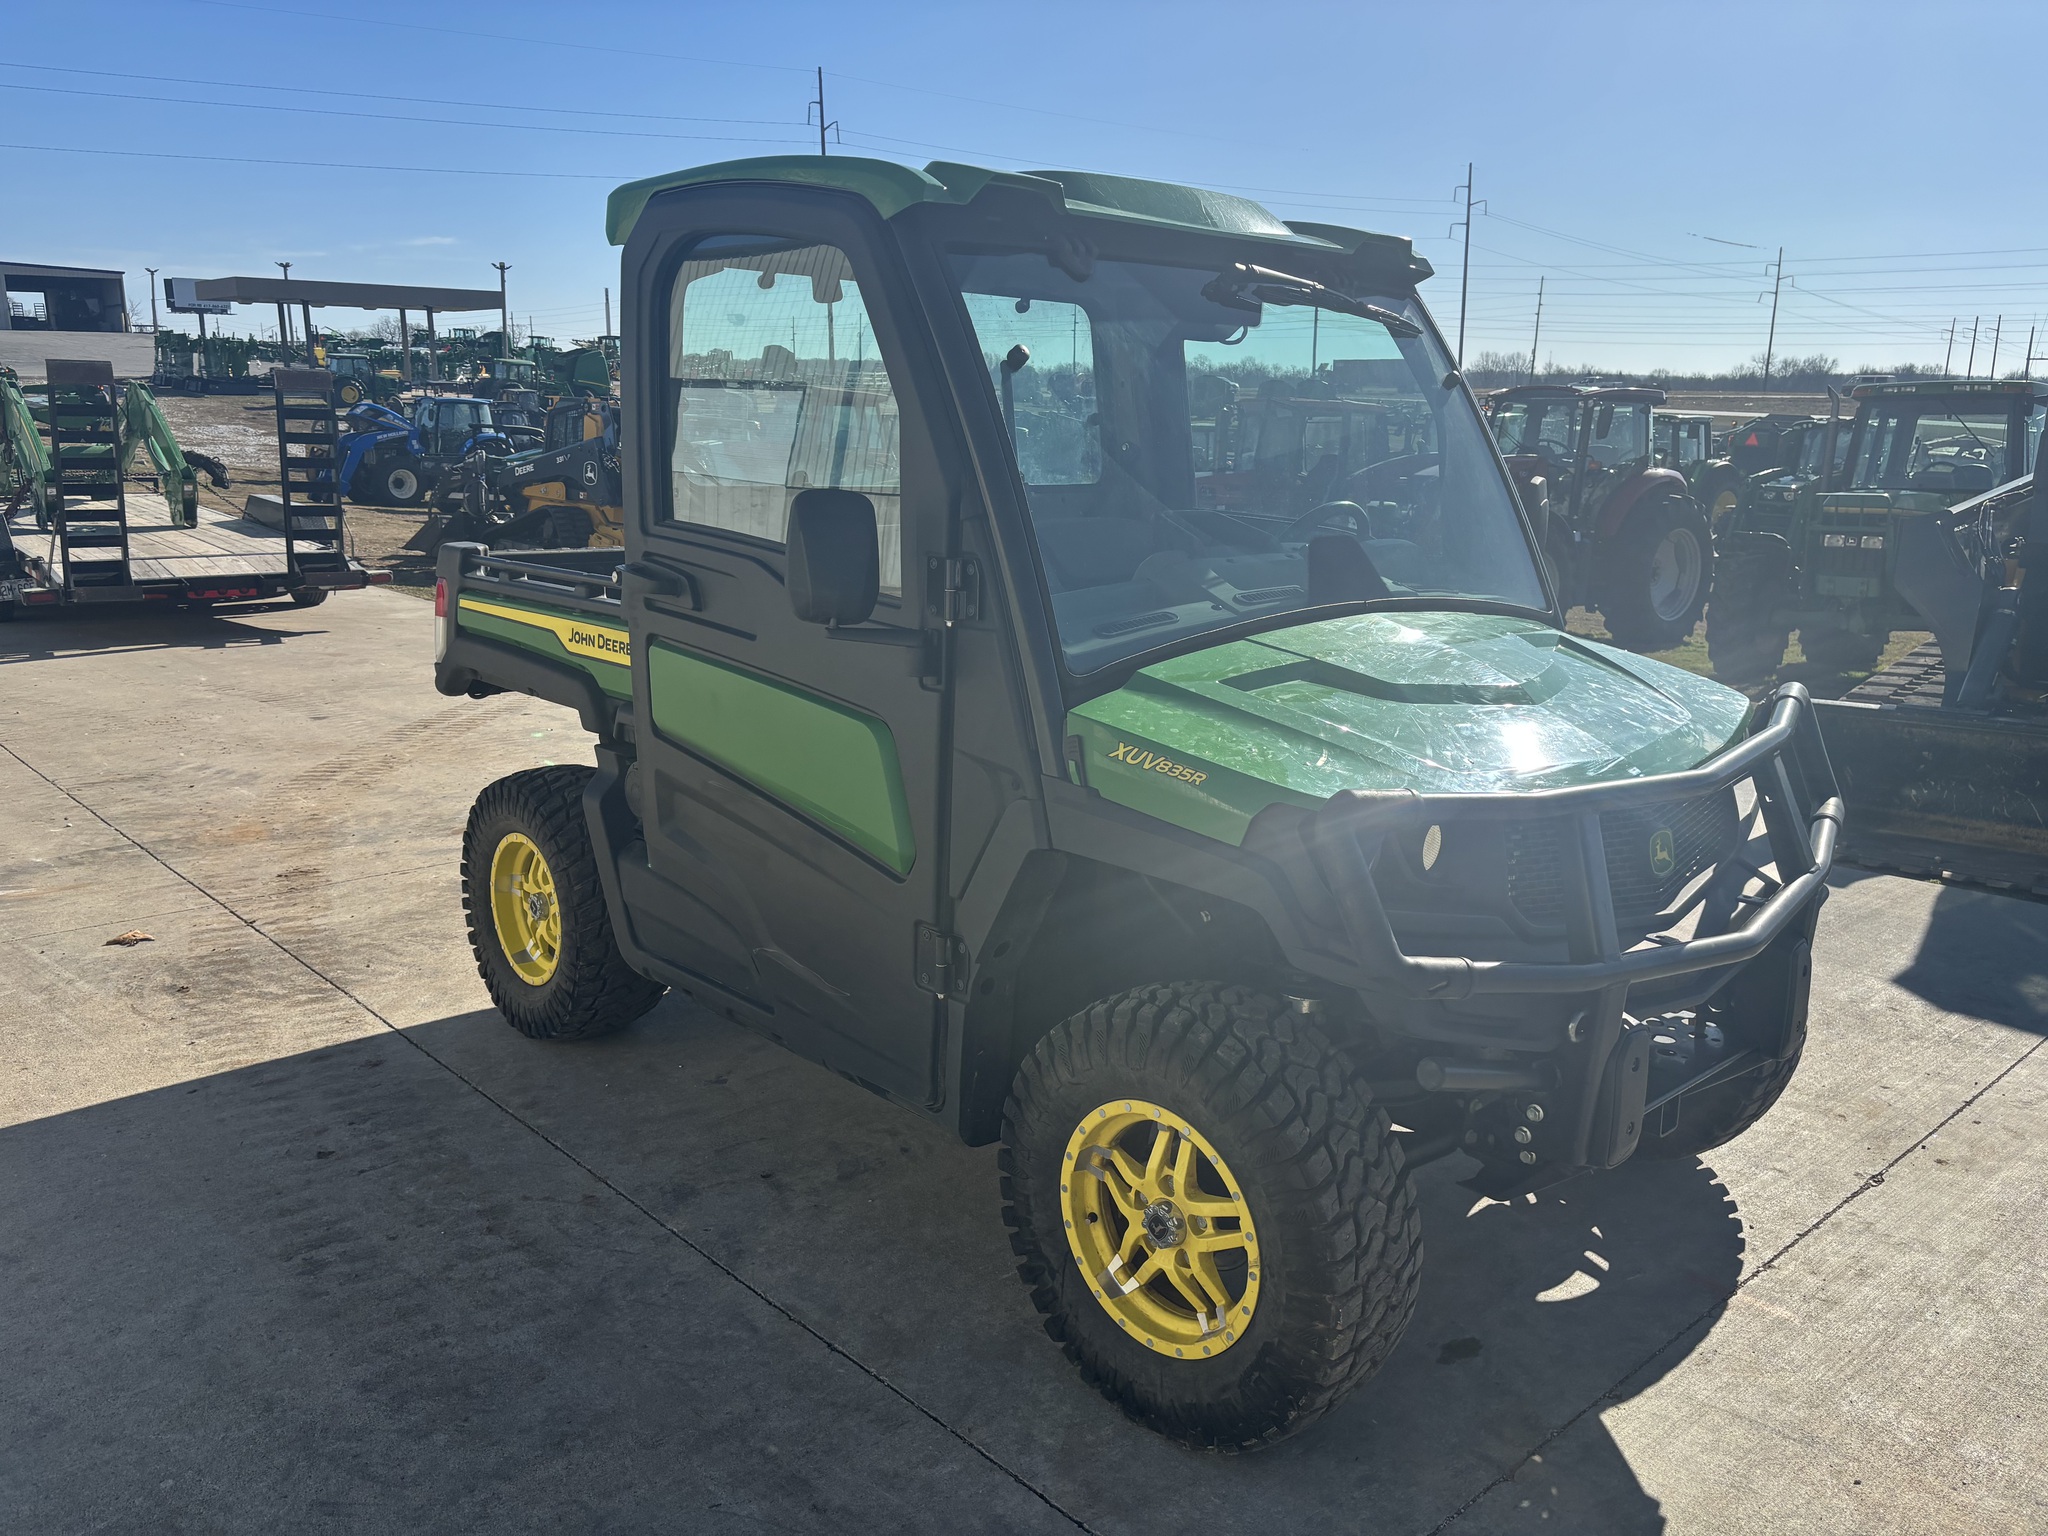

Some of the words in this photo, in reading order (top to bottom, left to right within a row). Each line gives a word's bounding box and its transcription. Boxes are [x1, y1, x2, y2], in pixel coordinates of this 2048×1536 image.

[514, 463, 534, 477] DEERE
[568, 627, 596, 648] JOHN
[597, 633, 632, 656] DEERE
[1107, 741, 1209, 786] XUV835R
